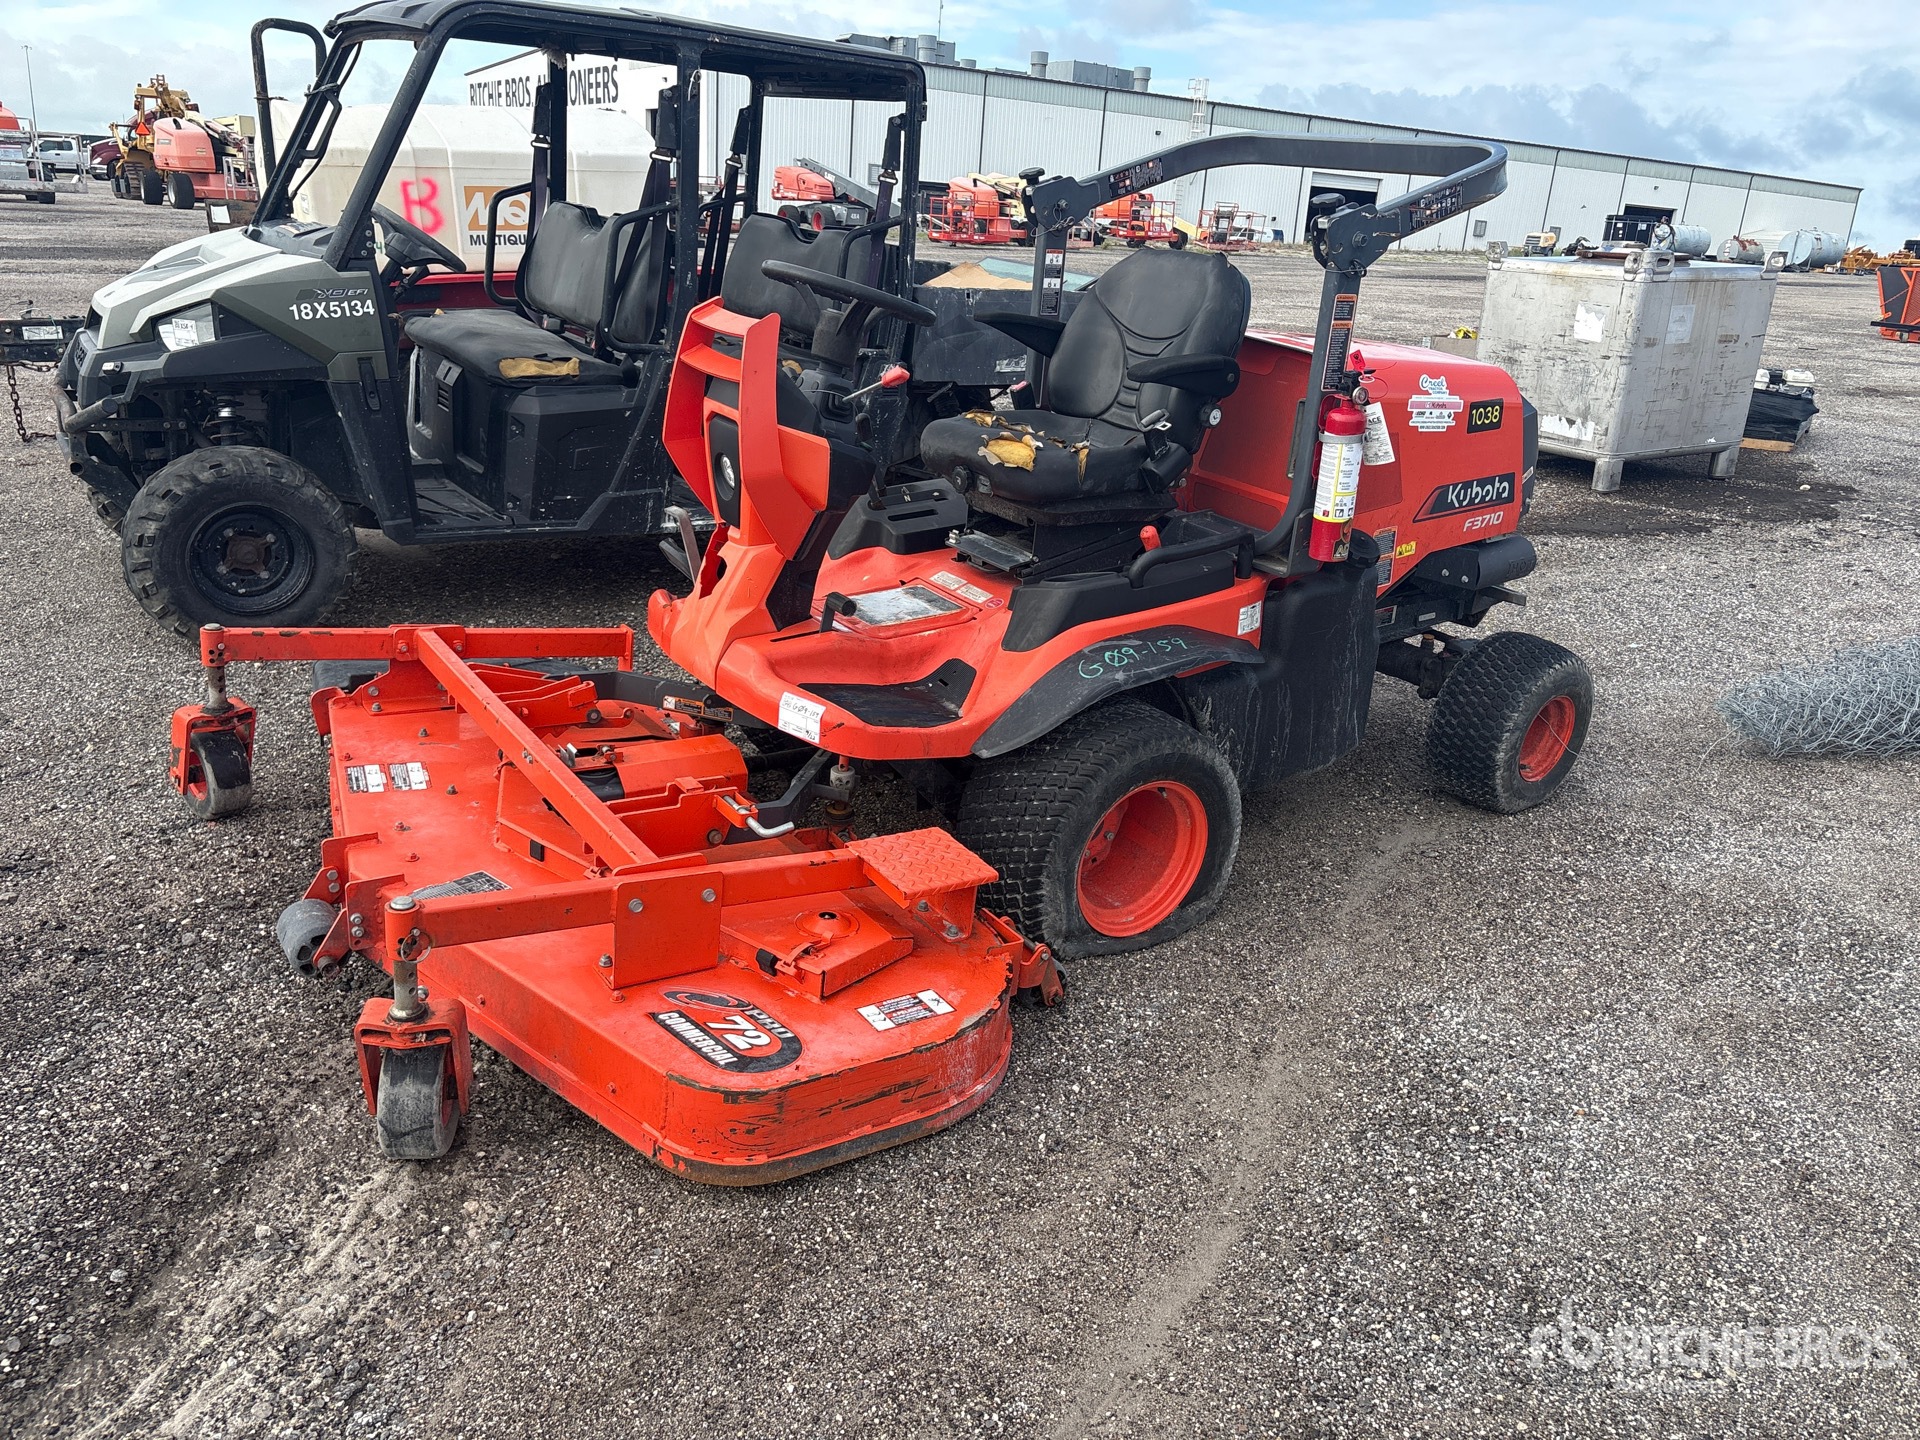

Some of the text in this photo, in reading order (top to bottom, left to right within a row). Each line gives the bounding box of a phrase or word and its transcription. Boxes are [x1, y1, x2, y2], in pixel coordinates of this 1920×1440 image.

[469, 79, 502, 107] RITCHIE
[400, 177, 445, 234] B
[289, 299, 375, 320] 18X5134
[1471, 405, 1500, 425] 1038
[1447, 476, 1509, 508] Kubota
[1463, 511, 1504, 532] F3710
[658, 1012, 738, 1066] COMMERCIAL
[705, 1014, 771, 1050] 72
